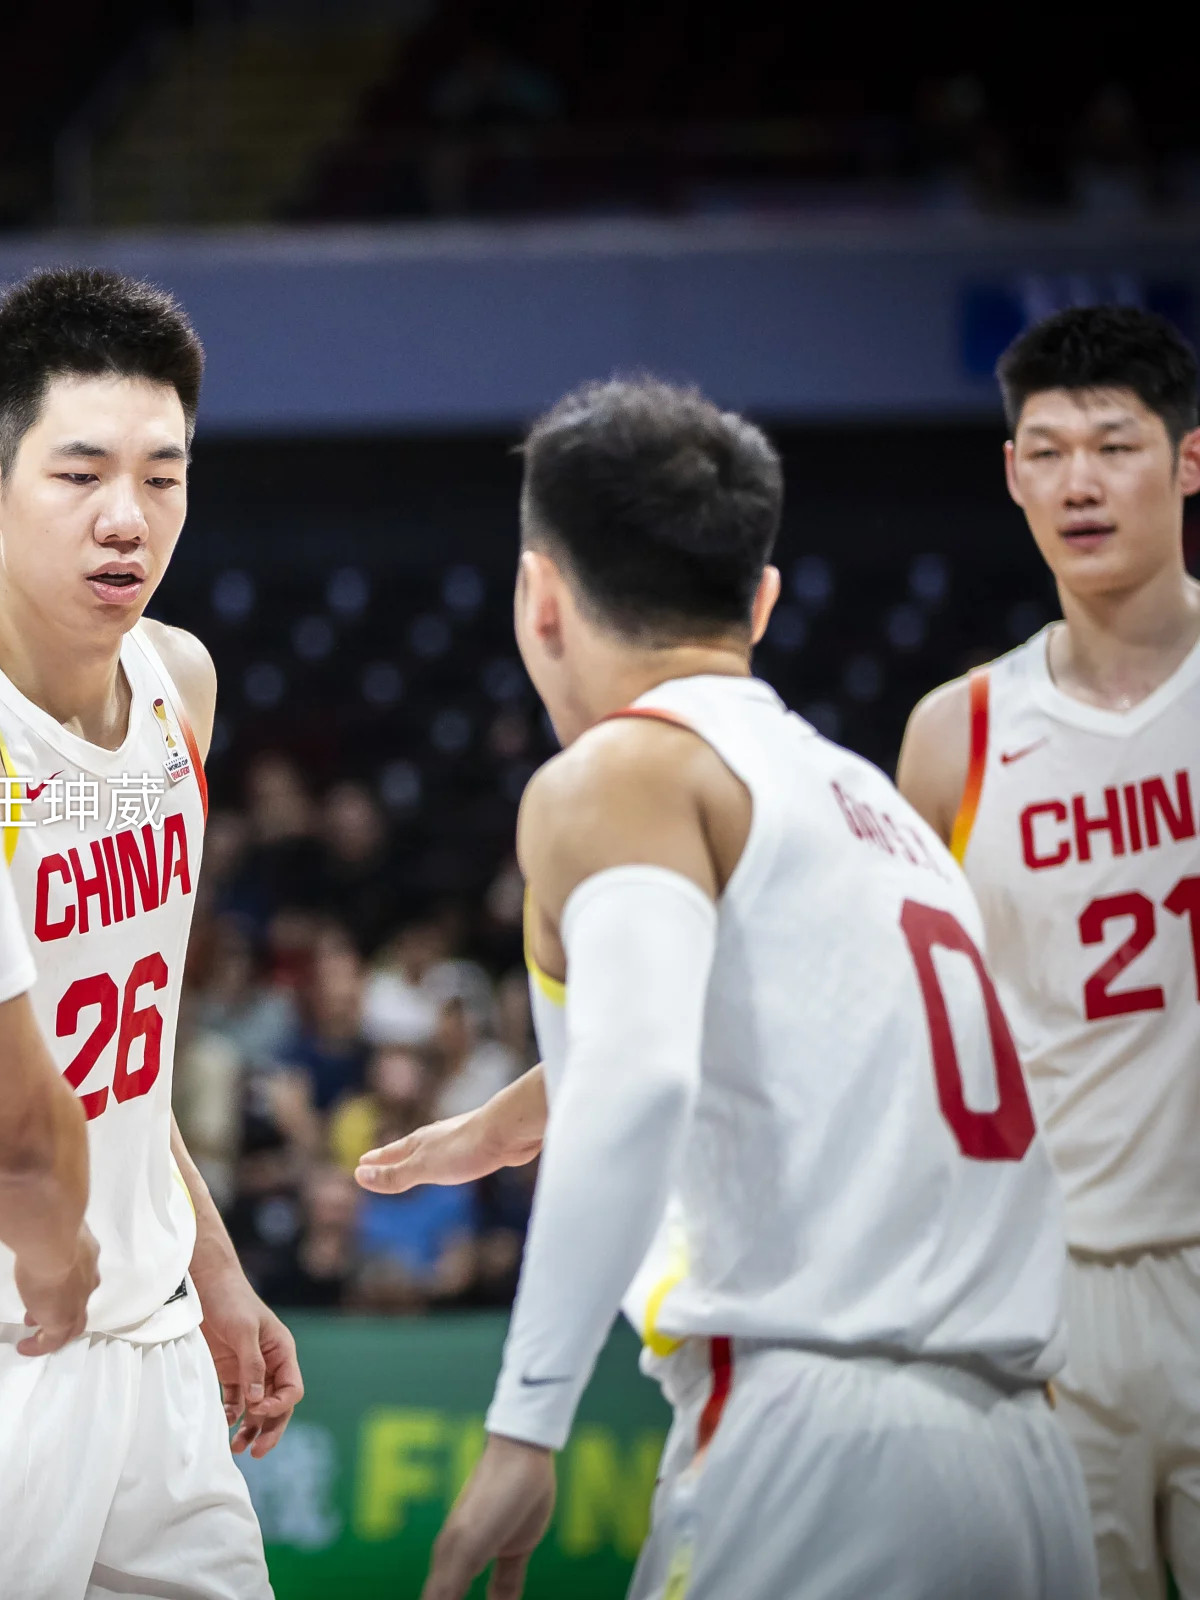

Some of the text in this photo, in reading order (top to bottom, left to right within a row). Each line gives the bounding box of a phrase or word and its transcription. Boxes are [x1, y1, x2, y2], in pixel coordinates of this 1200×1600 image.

[34, 812, 192, 943] CHINA
[1018, 767, 1200, 874] CHIN
[1077, 874, 1200, 1022] 21
[55, 951, 169, 1122] 26
[897, 897, 1037, 1162] 0
